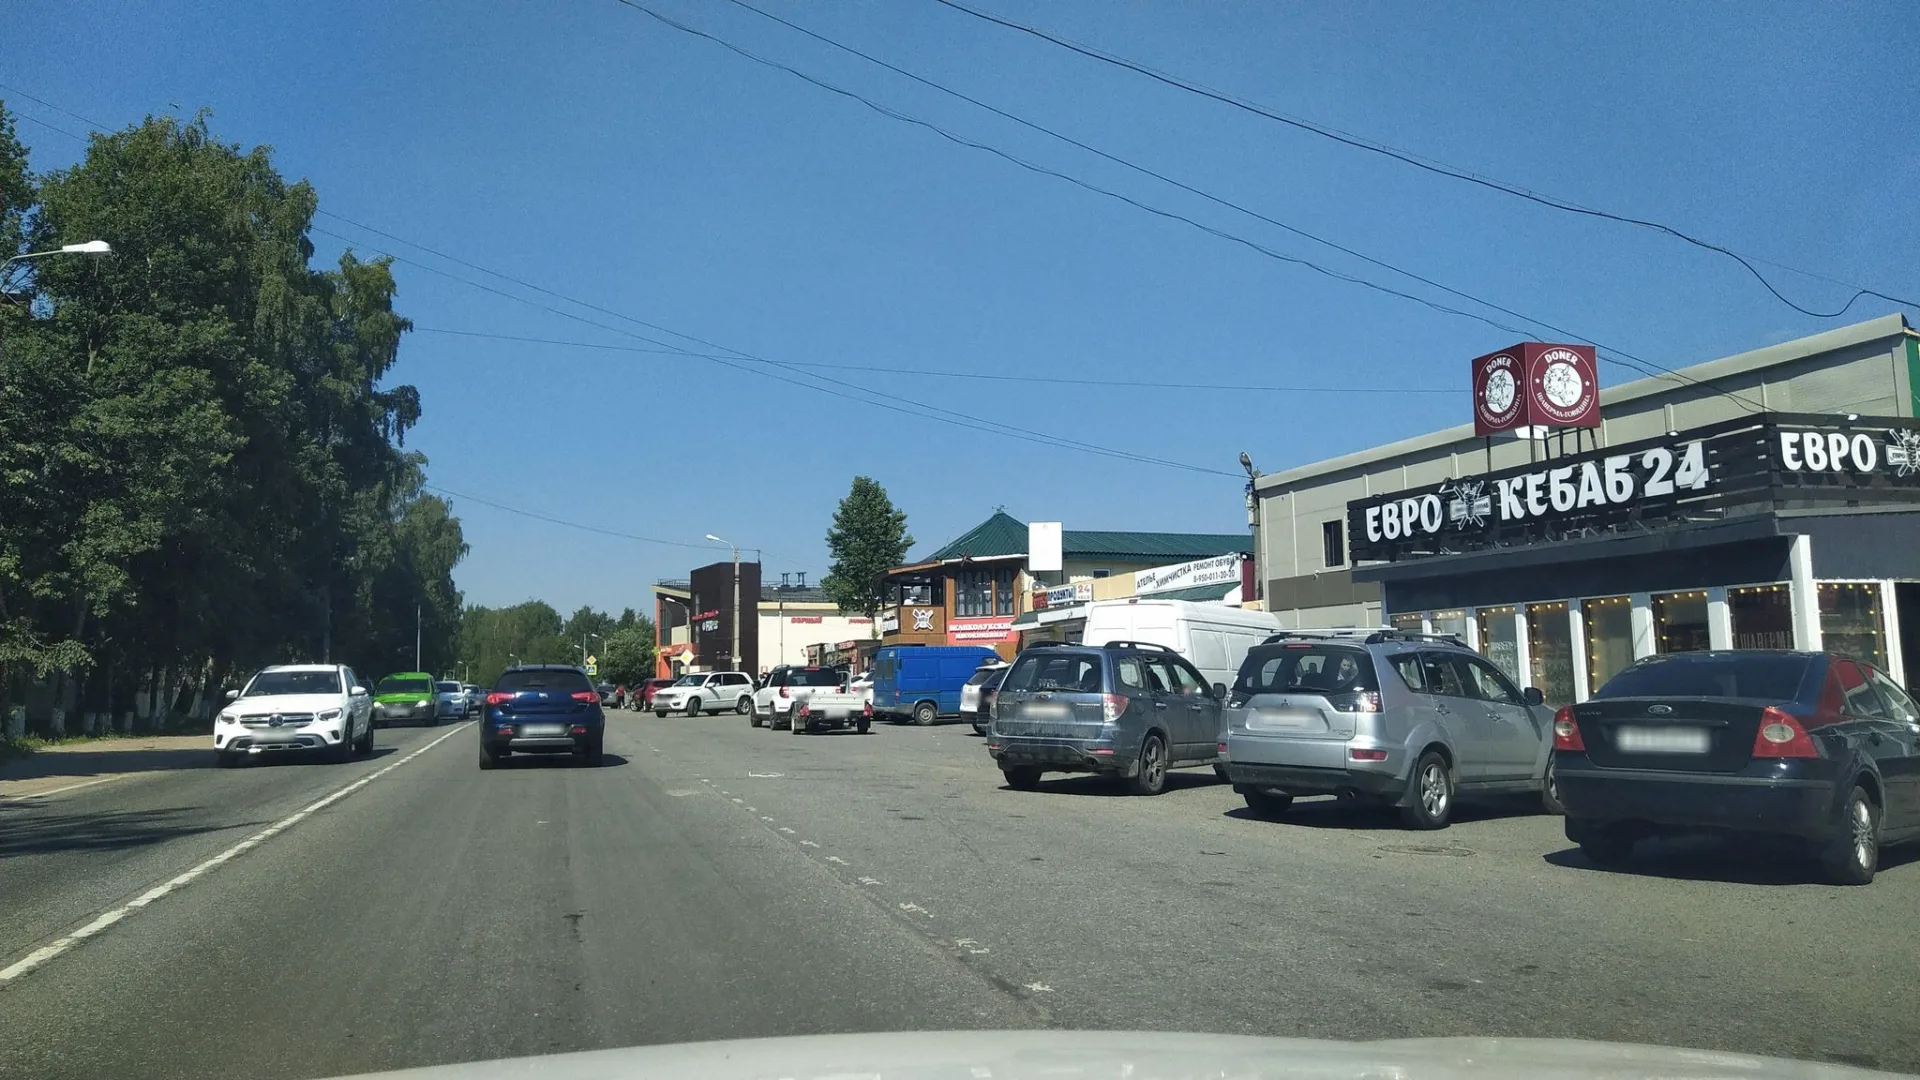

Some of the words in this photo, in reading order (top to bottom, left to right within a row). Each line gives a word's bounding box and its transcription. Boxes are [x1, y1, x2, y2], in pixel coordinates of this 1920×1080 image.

[1486, 356, 1512, 374] DONER
[1544, 350, 1579, 365] DONER
[1780, 431, 1877, 472] ЕВРО
[1365, 494, 1443, 542] ЕВРО
[1498, 455, 1635, 520] КЕБАБ
[1642, 441, 1709, 497] 24
[1136, 572, 1156, 589] АТЕЛЬЕ
[1155, 564, 1192, 588] ХИМЧИСТКА
[1193, 560, 1214, 571] РЕМОНТ
[1215, 555, 1236, 568] ОБУВИ
[1193, 569, 1236, 583] 8-950-011-20-20
[1047, 588, 1075, 602] ПРОДУКТЫ
[1077, 584, 1090, 594] 24
